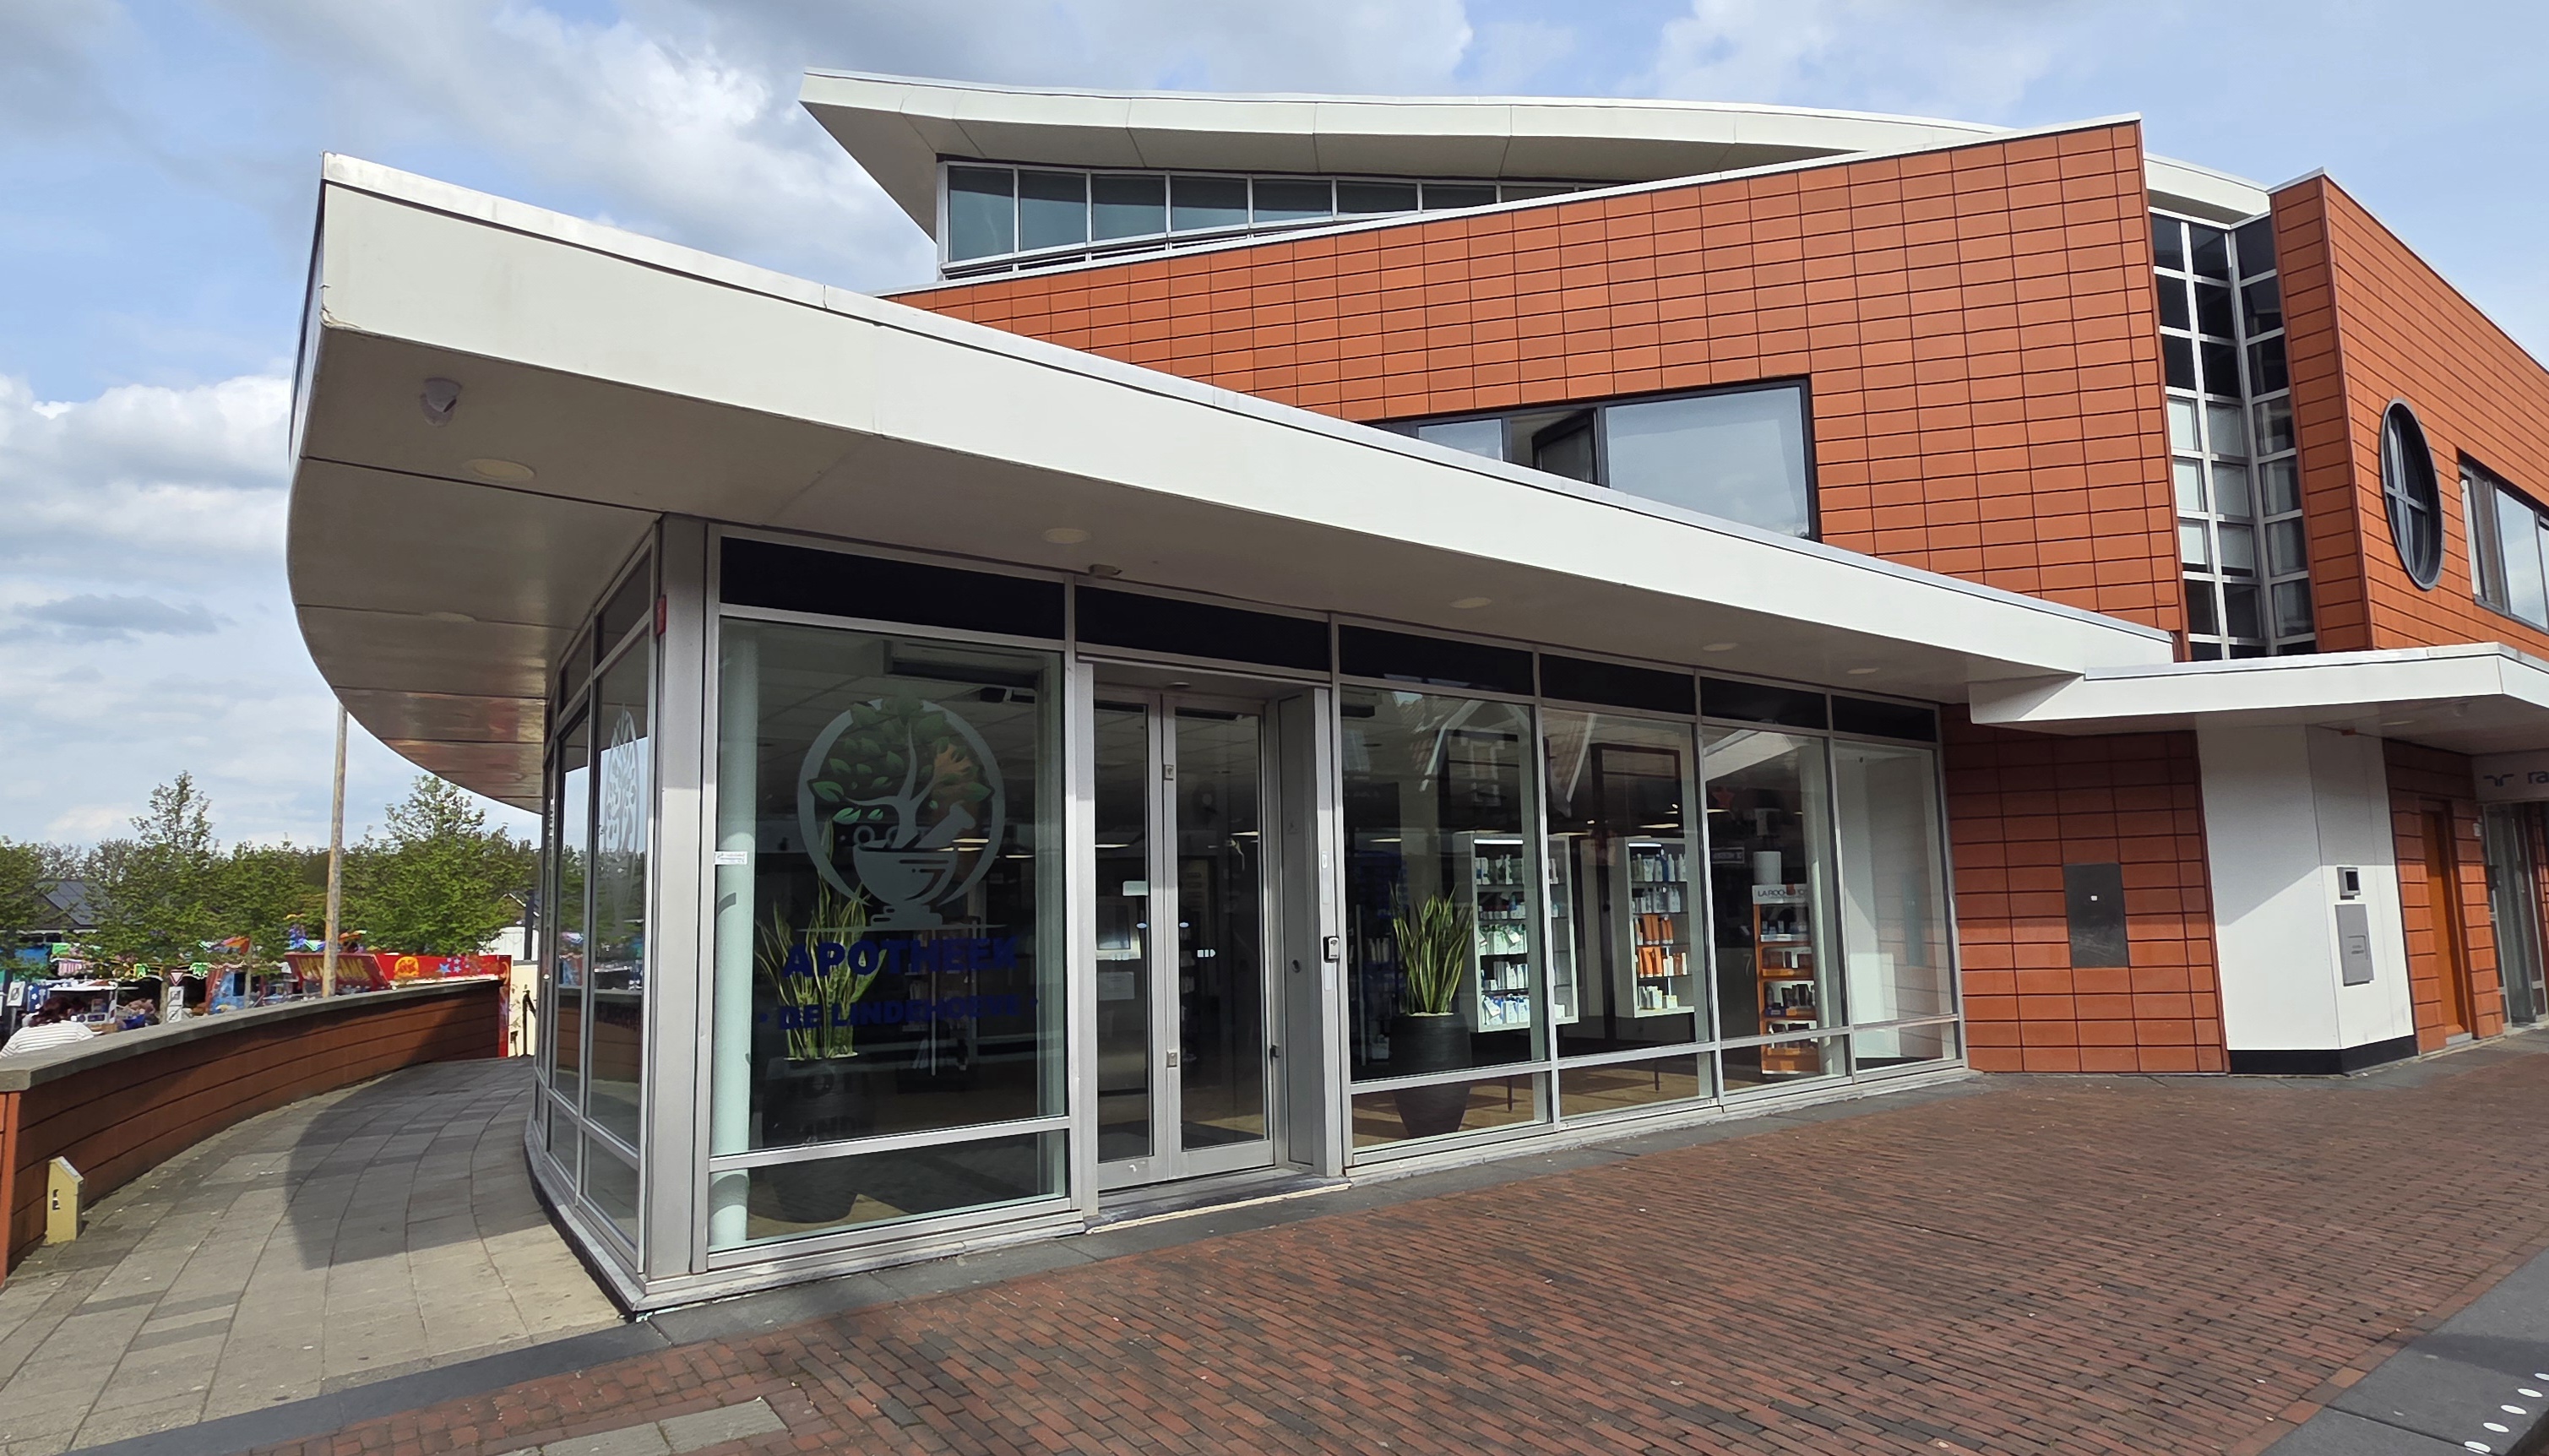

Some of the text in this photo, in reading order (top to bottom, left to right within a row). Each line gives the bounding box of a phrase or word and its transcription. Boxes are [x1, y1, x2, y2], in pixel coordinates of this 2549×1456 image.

[782, 936, 1018, 978] APOTHEEK
[779, 994, 1020, 1030] DE LINDEHOEVE
